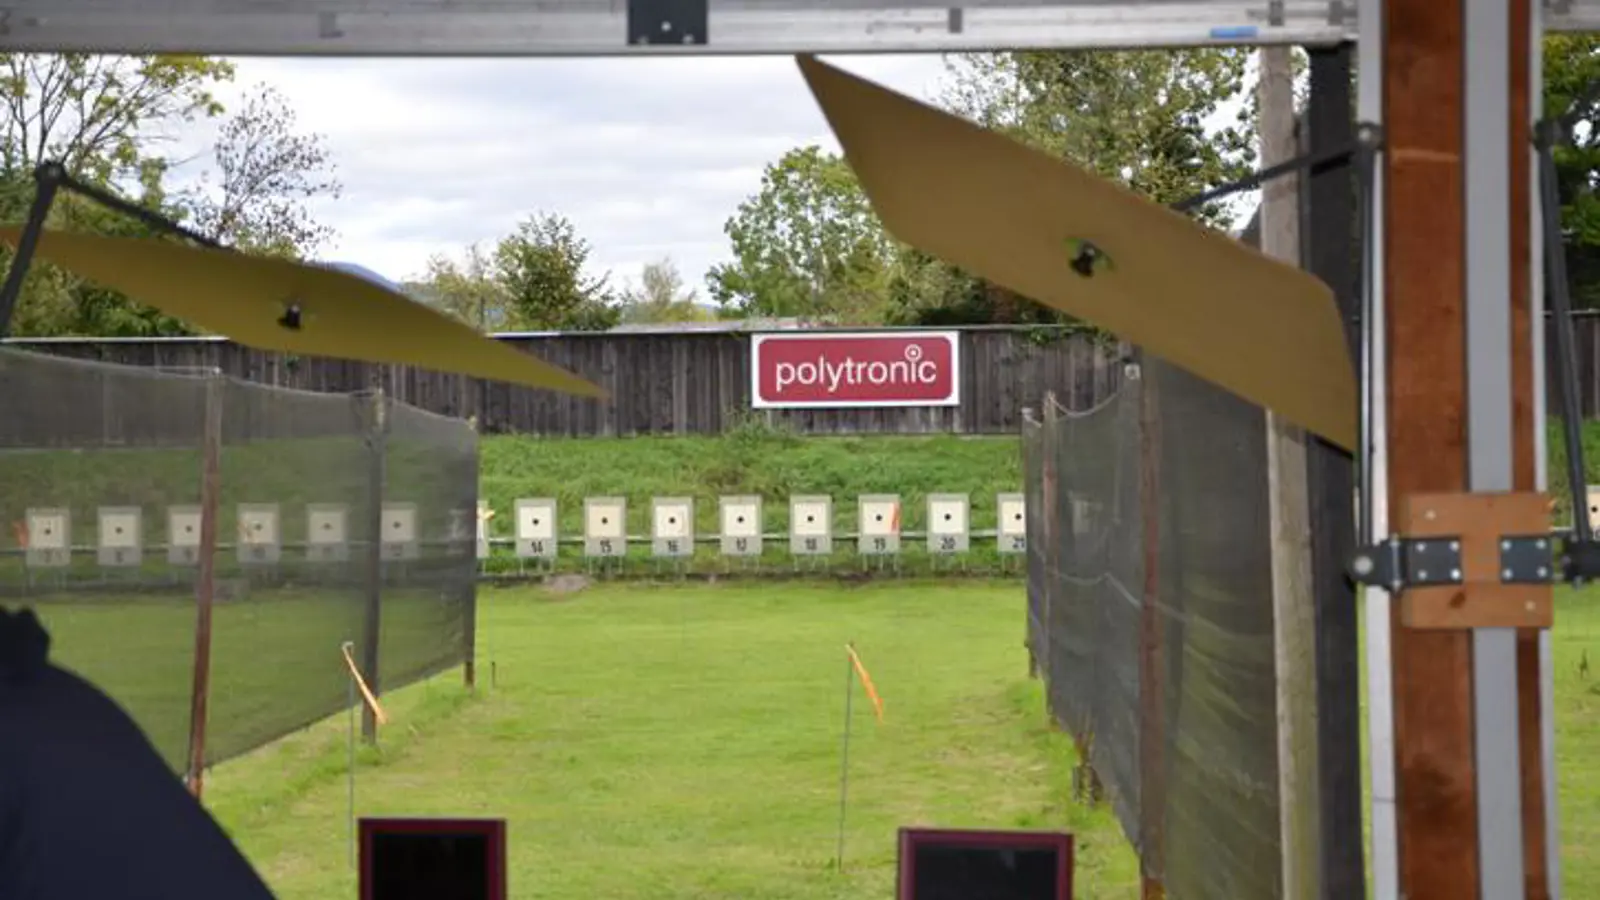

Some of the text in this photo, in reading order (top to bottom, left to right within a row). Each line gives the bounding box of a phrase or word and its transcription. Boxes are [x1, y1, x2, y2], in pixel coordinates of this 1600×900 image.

[775, 344, 937, 392] polytronic
[531, 541, 544, 553] 14
[599, 540, 612, 553] 15
[667, 540, 679, 552] 16
[874, 538, 886, 550] 19
[941, 536, 956, 549] 20
